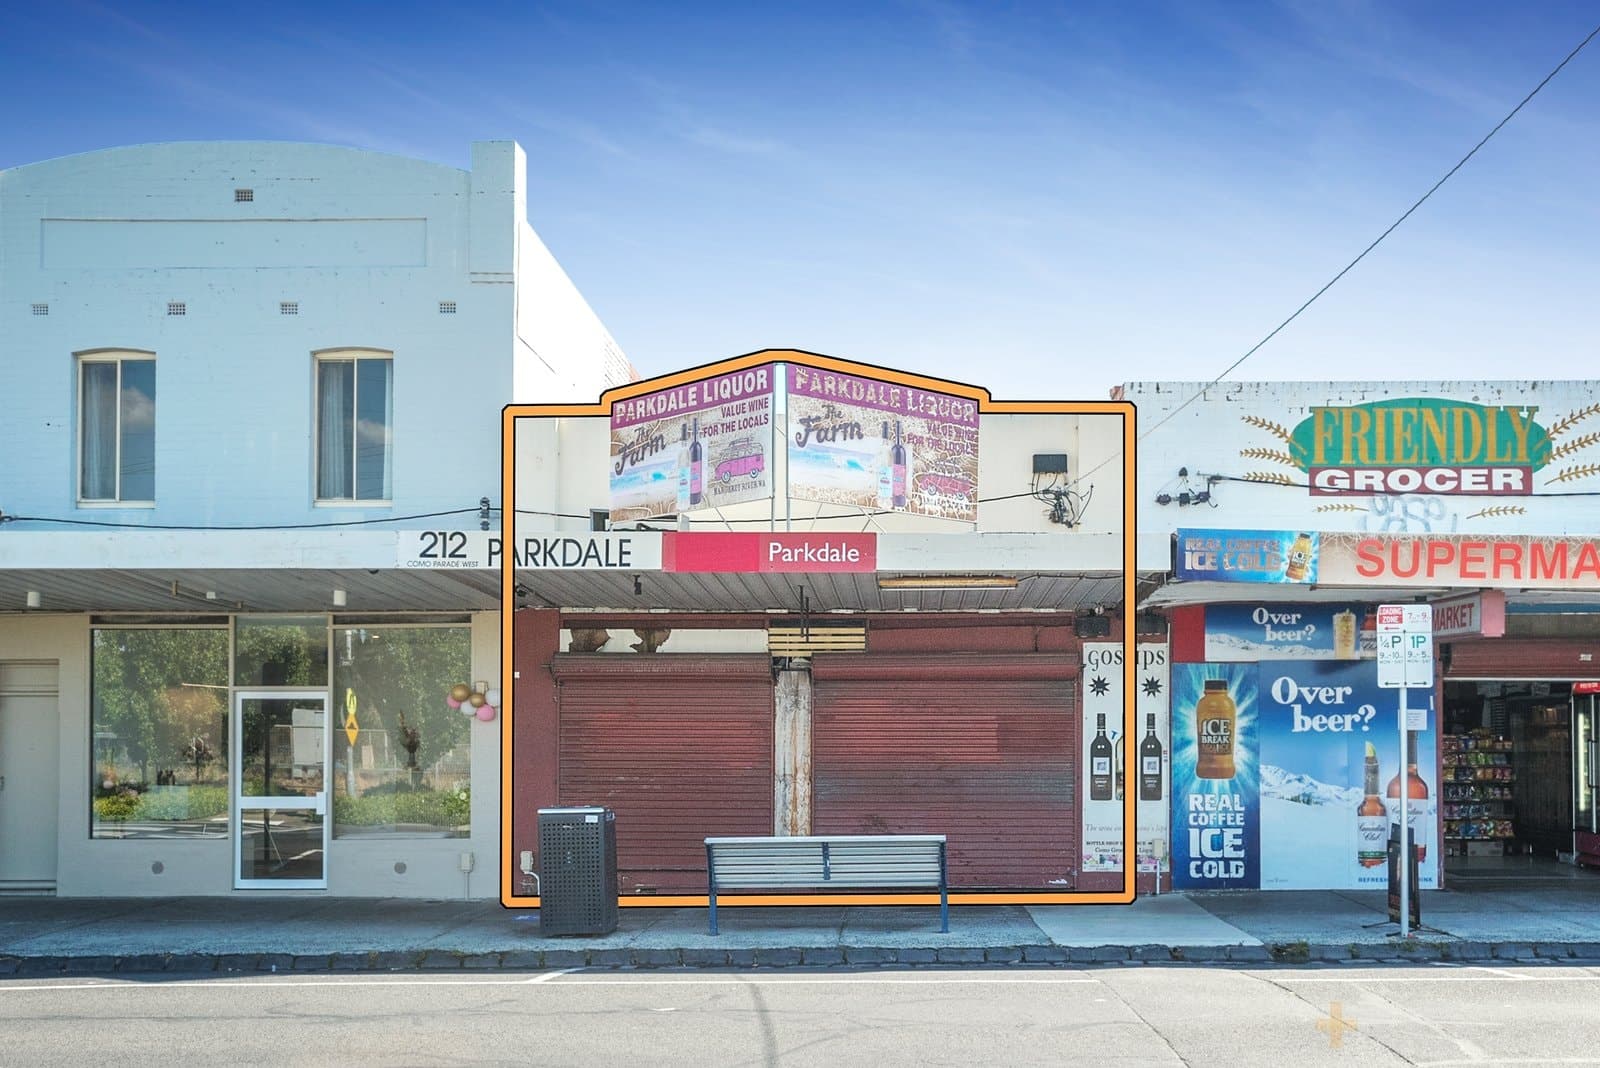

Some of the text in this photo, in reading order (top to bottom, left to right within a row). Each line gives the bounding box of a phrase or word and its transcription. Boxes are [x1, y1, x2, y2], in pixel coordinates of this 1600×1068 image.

[616, 369, 768, 424] PARKDALE LIQUOR
[794, 367, 901, 408] PARKDALE
[721, 397, 769, 418] VALUE WINE
[703, 413, 769, 438] FOR THE LOCALS
[795, 415, 864, 449] Farm
[1309, 406, 1539, 464] FRIENDLY
[614, 434, 667, 476] Farm
[1315, 468, 1523, 492] GROCER
[419, 531, 467, 558] 212
[769, 542, 860, 562] Parkdale
[406, 560, 479, 568] COMO PARADE WEST
[1184, 551, 1218, 570] ICE
[1252, 607, 1302, 625] Over
[1382, 615, 1399, 624] ZONE
[1264, 624, 1316, 641] beer?
[1411, 635, 1427, 649] 1P
[1271, 676, 1353, 705] Over
[1202, 719, 1231, 736] ICE
[1290, 704, 1377, 733] beer?
[1201, 735, 1230, 744] BREAK
[1188, 794, 1245, 812] REAL
[1188, 813, 1245, 826] COFFEE
[1188, 827, 1245, 859] ICE
[1189, 860, 1245, 879] COLD
